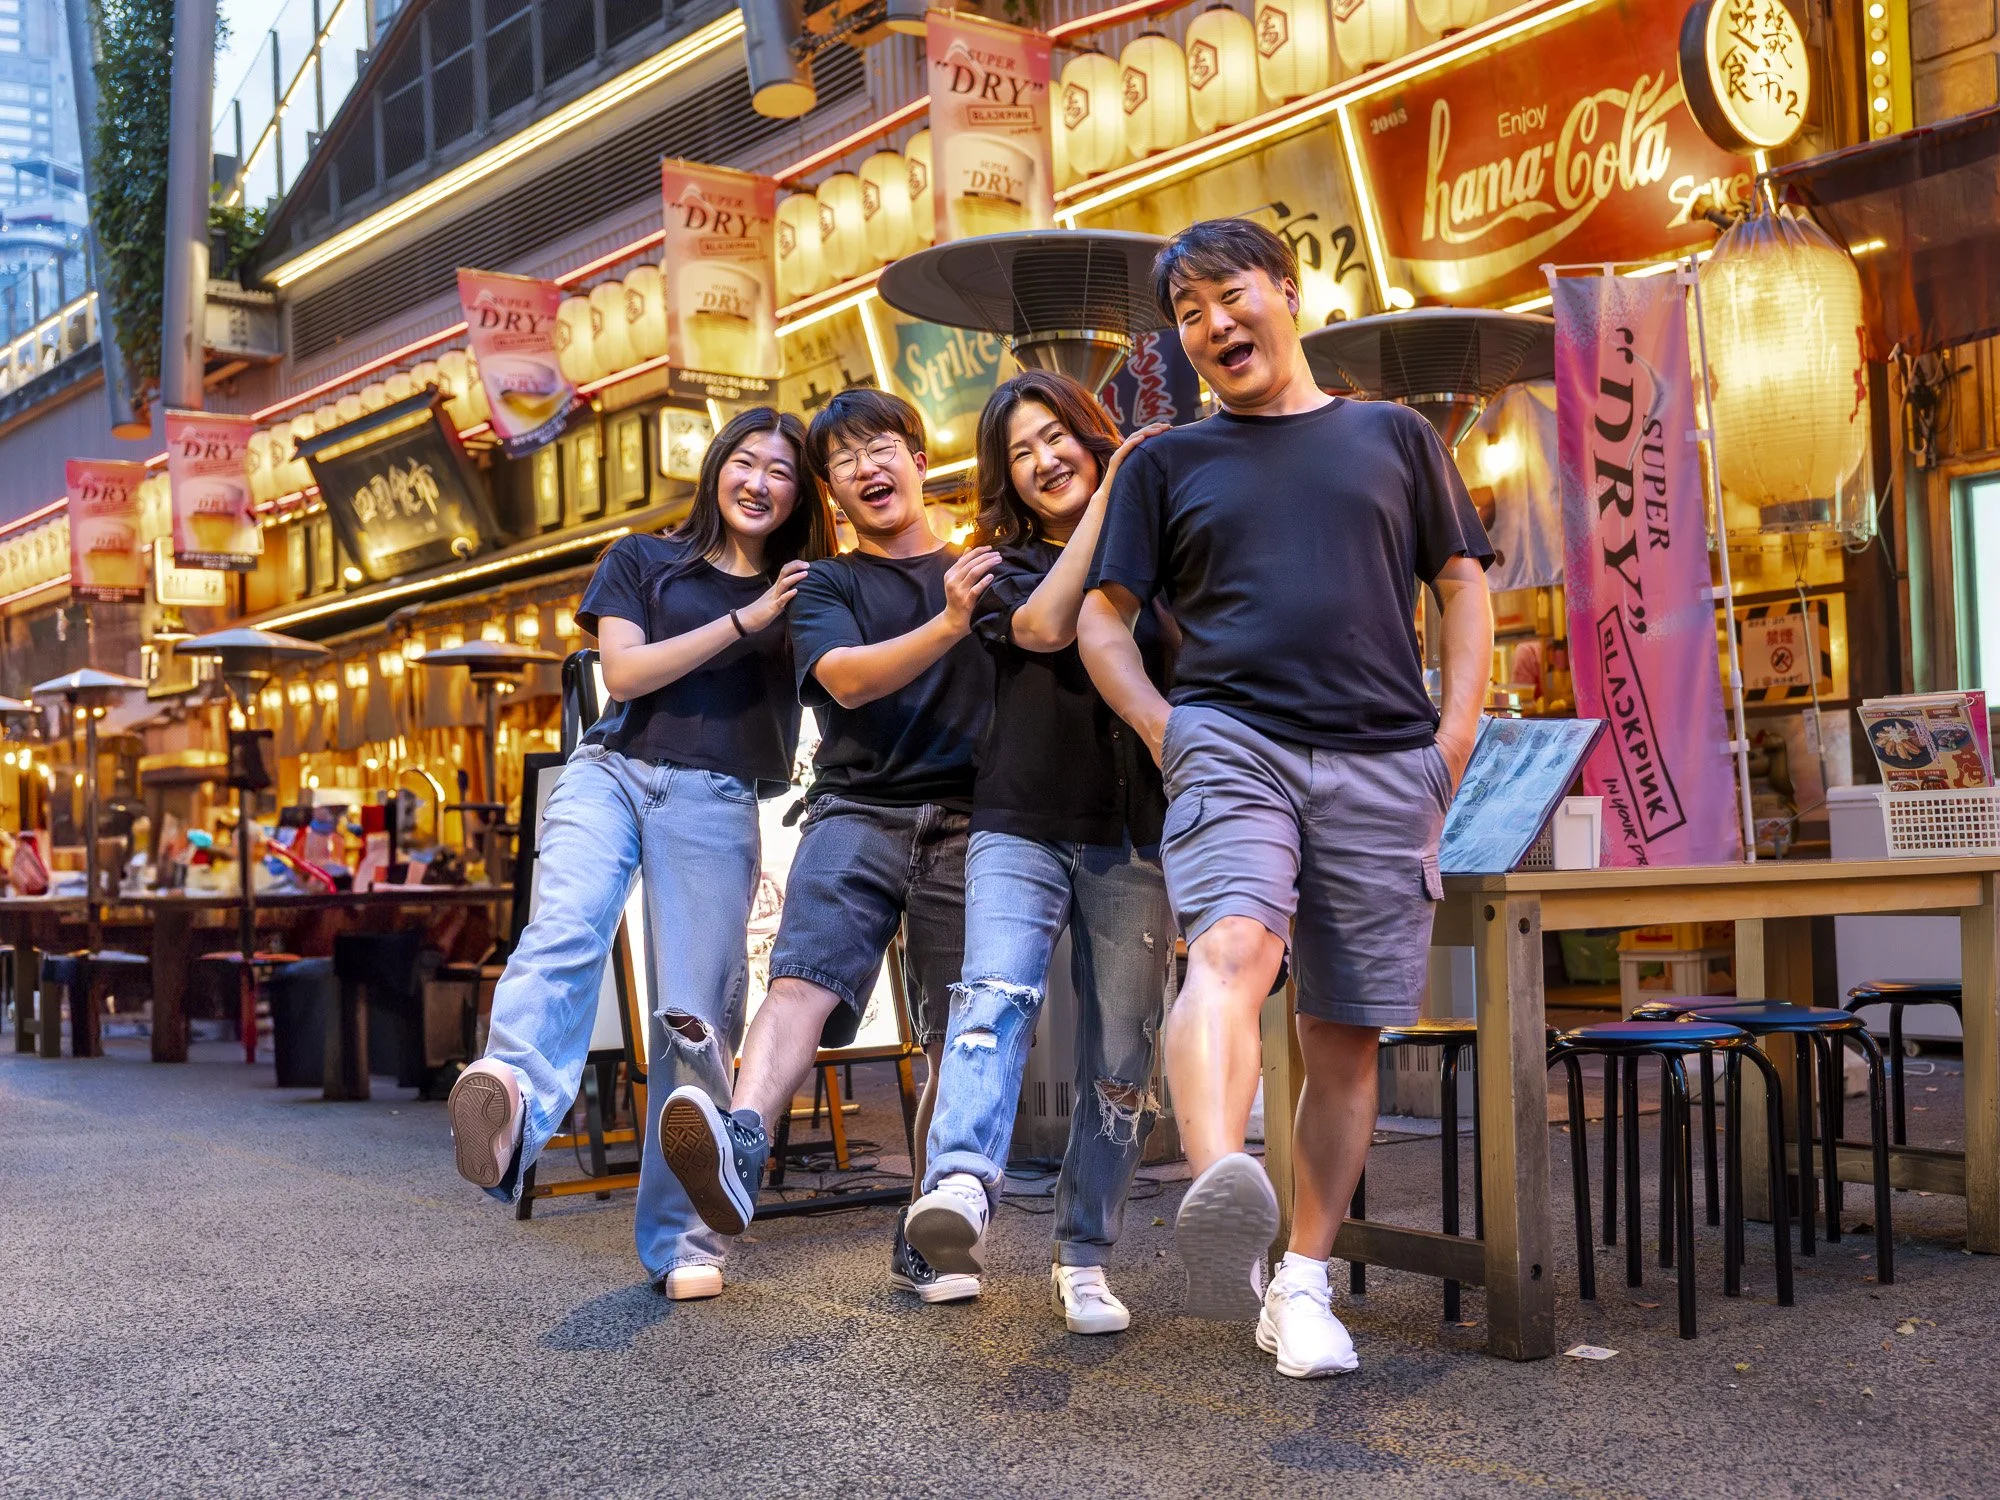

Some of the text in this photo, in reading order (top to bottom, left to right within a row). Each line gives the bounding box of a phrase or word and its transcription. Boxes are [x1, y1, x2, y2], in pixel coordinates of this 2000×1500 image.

[969, 50, 1016, 71] SUPER
[1498, 104, 1548, 138] Enjoy
[1639, 413, 1672, 552] SUPER
[1602, 626, 1669, 823] BLACKPINK
[1601, 777, 1621, 793] IN
[1608, 796, 1638, 843] YOUR
